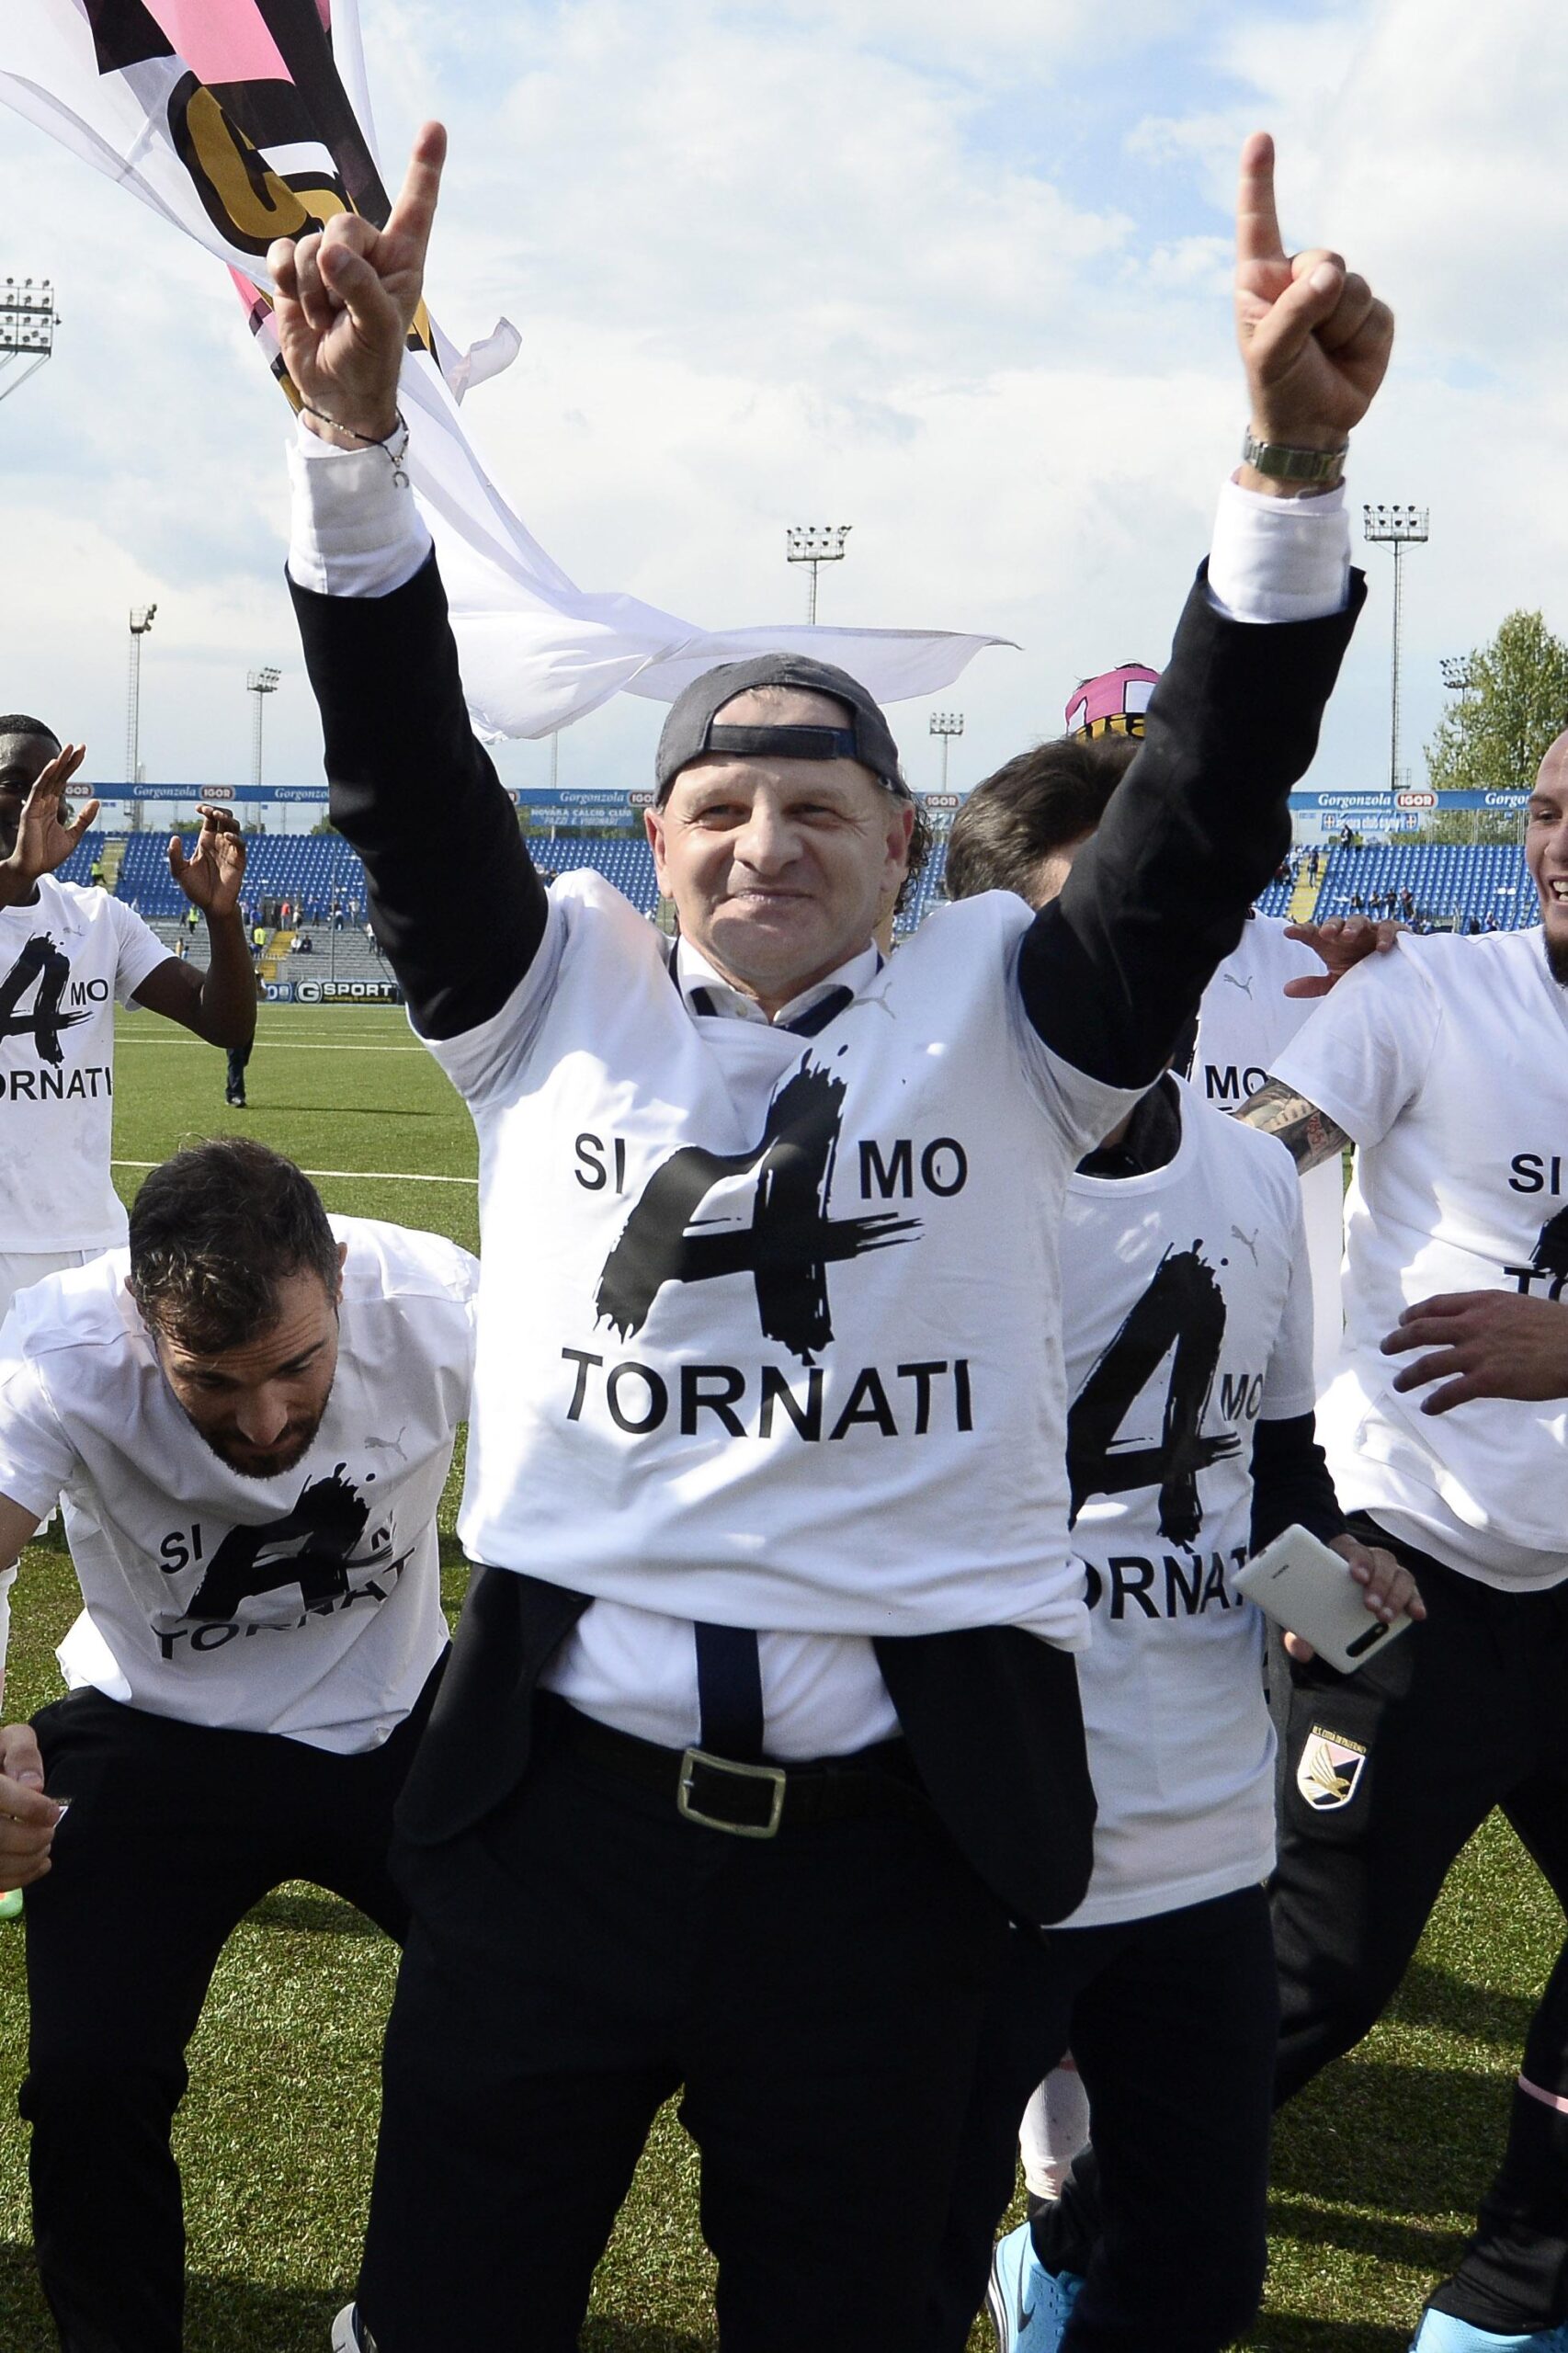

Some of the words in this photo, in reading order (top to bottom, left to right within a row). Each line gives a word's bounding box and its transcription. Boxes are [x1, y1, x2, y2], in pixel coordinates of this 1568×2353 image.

[65, 786, 89, 796] GOR
[133, 785, 196, 798] Gorgonzola
[203, 788, 231, 798] IGOR
[560, 791, 625, 804] Gorgonzola
[631, 793, 654, 803] IGO
[927, 796, 956, 807] IGOR
[1318, 792, 1392, 809] Gorgonzola
[1400, 794, 1432, 805] IGOR
[573, 809, 605, 817] CALCIO
[71, 979, 108, 1006] MO
[324, 983, 392, 996] SPORT
[1204, 1064, 1268, 1099] MO
[574, 1132, 626, 1194] SI
[858, 1137, 968, 1199] MO
[1507, 1154, 1561, 1196] SI
[592, 1046, 925, 1367] 4
[562, 1347, 973, 1443] TORNATI
[1064, 1238, 1243, 1555] 4
[1221, 1373, 1264, 1421] MO
[159, 1522, 203, 1574] SI
